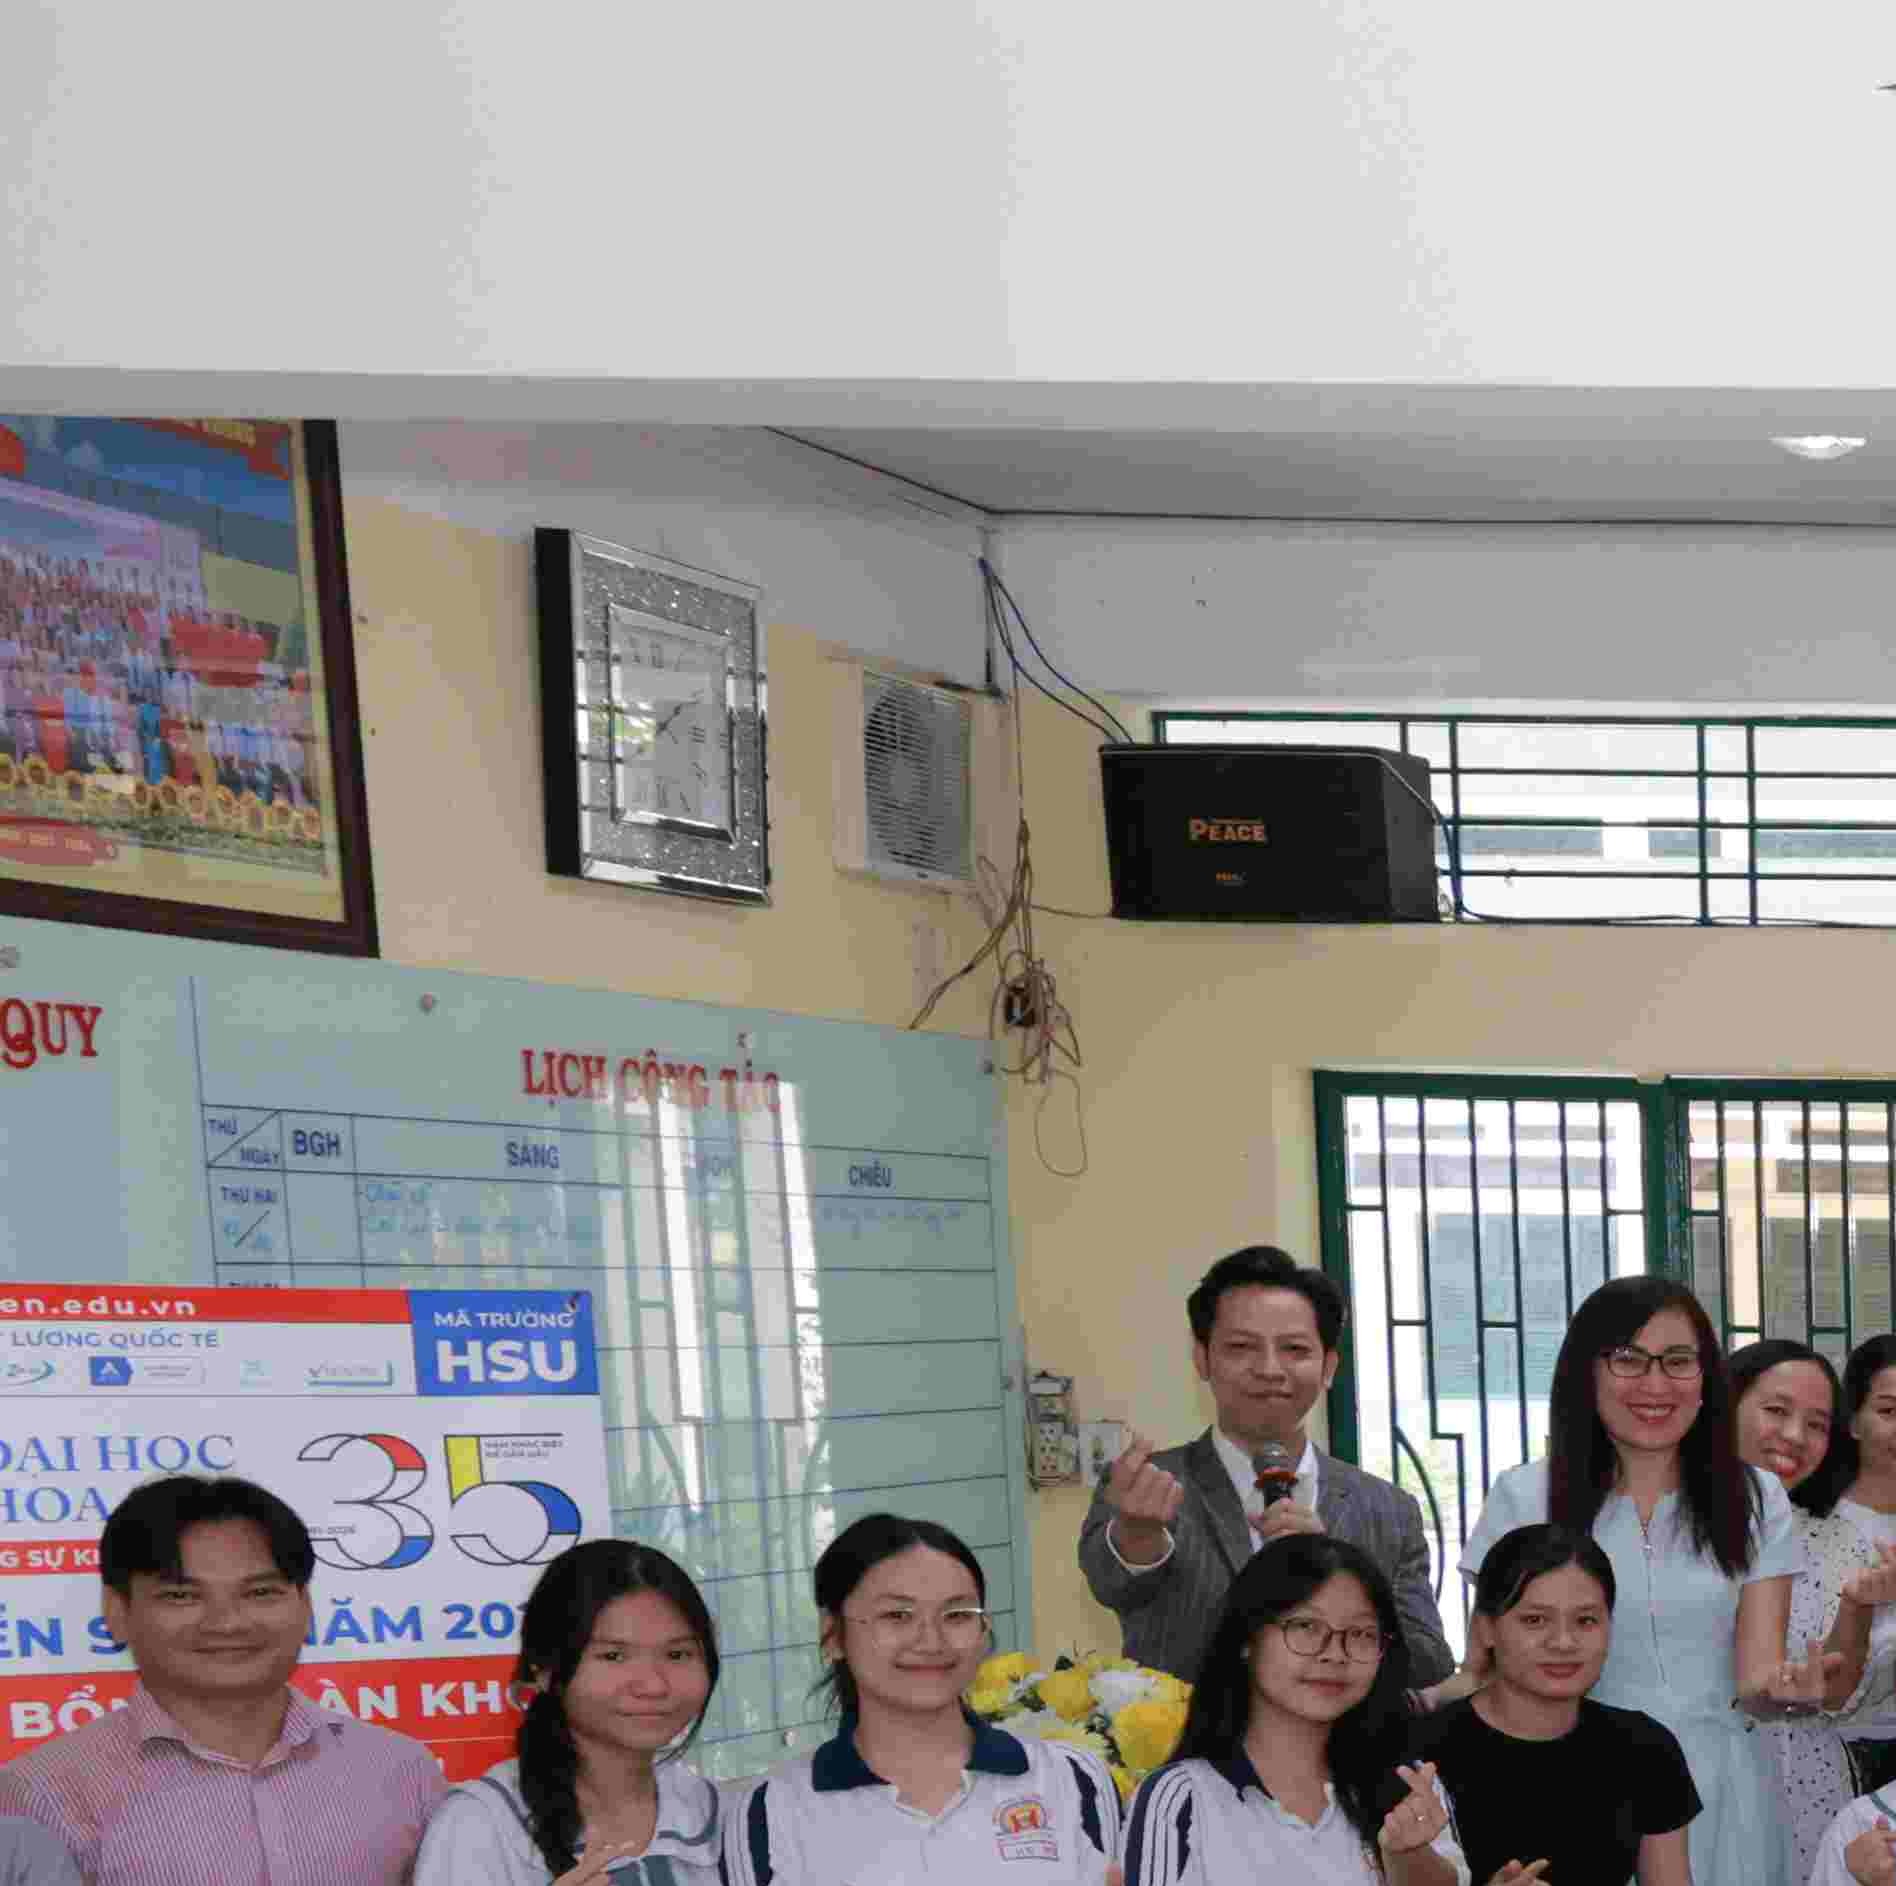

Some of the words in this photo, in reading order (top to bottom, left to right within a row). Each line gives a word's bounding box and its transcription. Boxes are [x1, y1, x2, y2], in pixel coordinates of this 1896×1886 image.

[520, 1049, 606, 1109] LỊCH
[617, 1048, 711, 1112] CÔNG
[293, 1130, 342, 1157] BGH
[437, 1339, 577, 1383] HSU
[94, 1434, 235, 1477] HỌC
